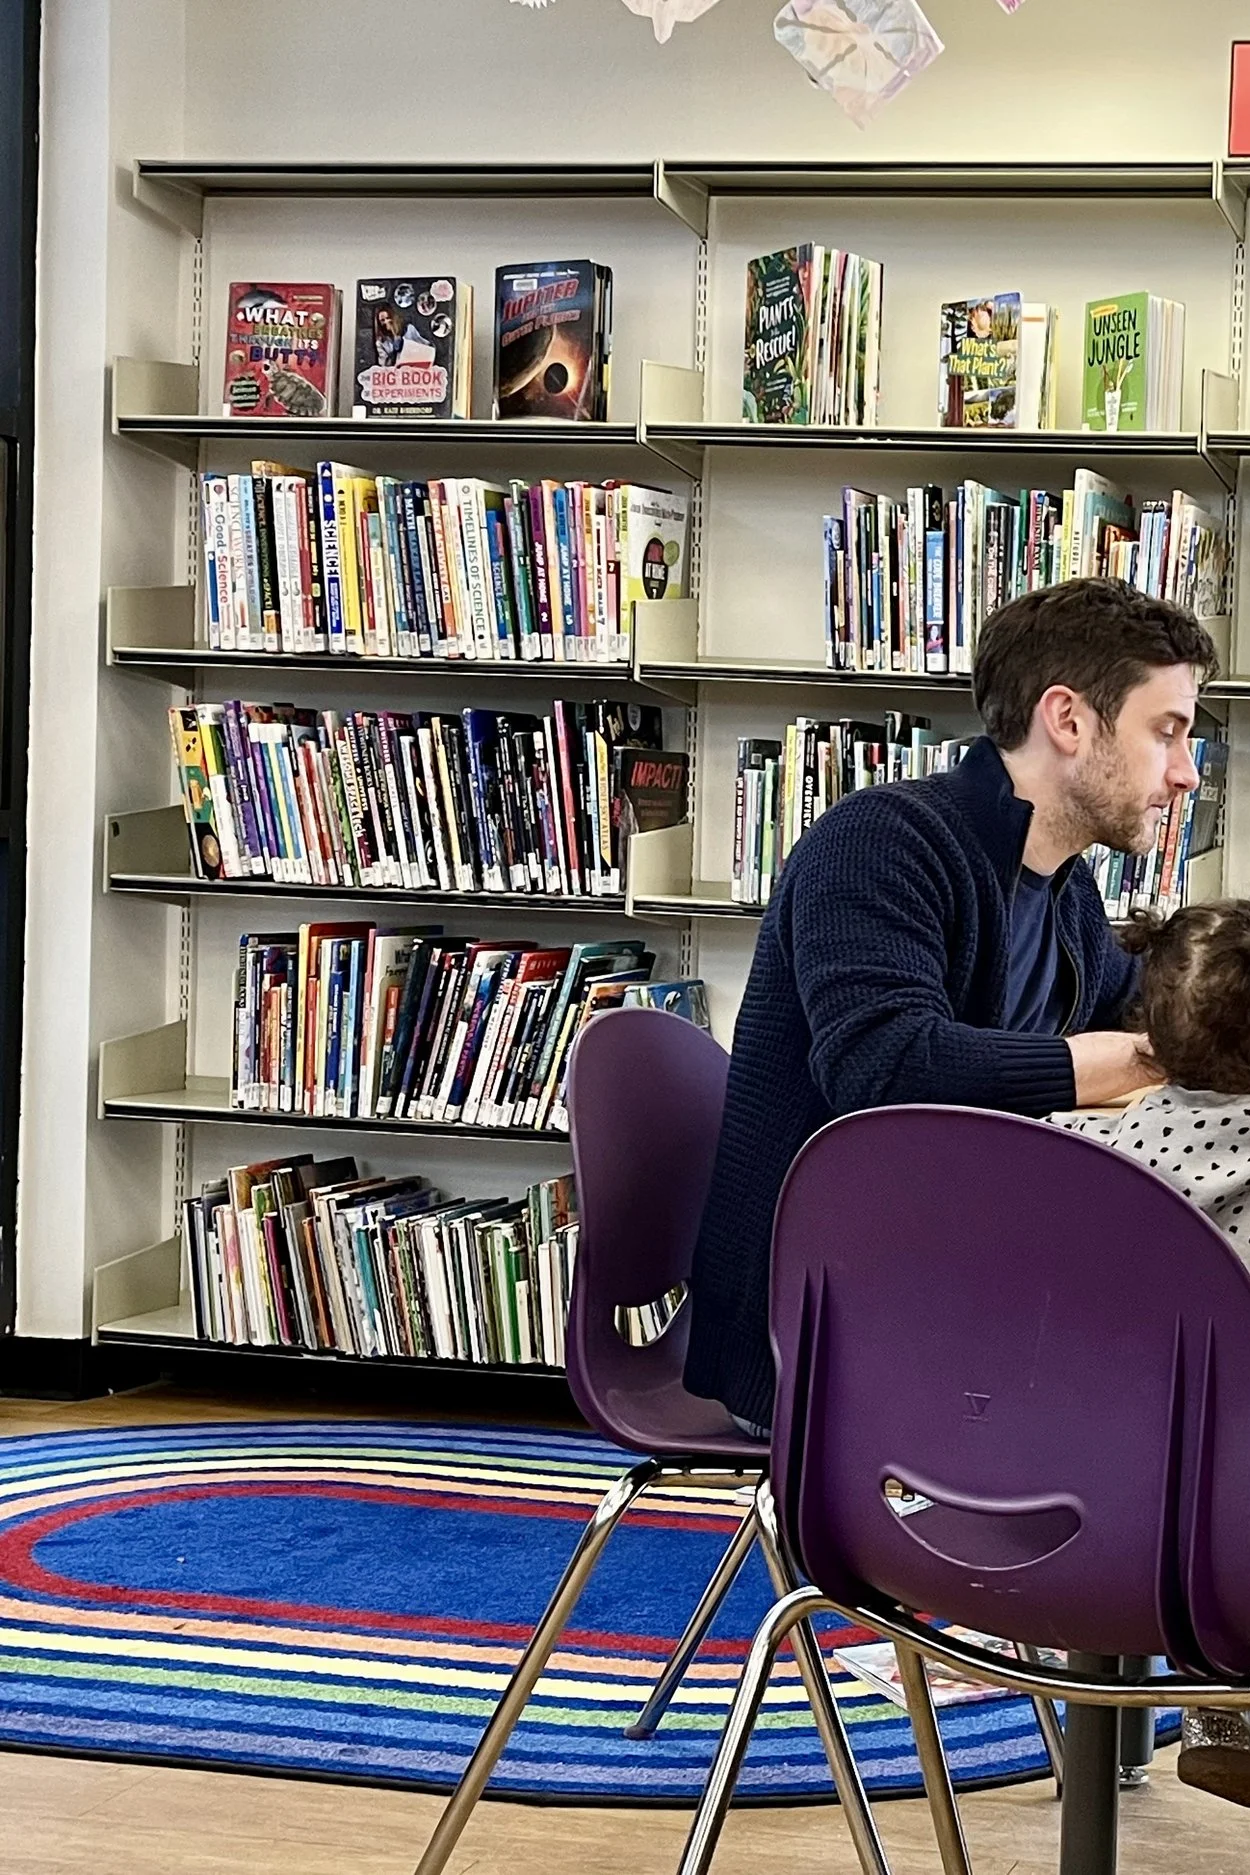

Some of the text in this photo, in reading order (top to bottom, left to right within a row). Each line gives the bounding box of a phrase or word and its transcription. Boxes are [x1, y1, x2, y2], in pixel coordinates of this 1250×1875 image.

[245, 307, 309, 326] WHAT
[1093, 309, 1137, 336] UNSEEN
[299, 340, 319, 349] ITS
[962, 338, 996, 356] What's
[1088, 332, 1140, 366] JUNGLE
[372, 372, 442, 386] BIG BOOK
[949, 355, 1005, 378] That Plant?
[372, 388, 442, 398] EXPERIMENTS
[404, 498, 415, 529] MATH
[215, 514, 227, 548] Good
[325, 520, 338, 575] SCIENCE
[217, 555, 229, 603] Science
[463, 500, 485, 631] TIMELINES OF SCIENCE
[803, 775, 814, 828] OVERVIEW
